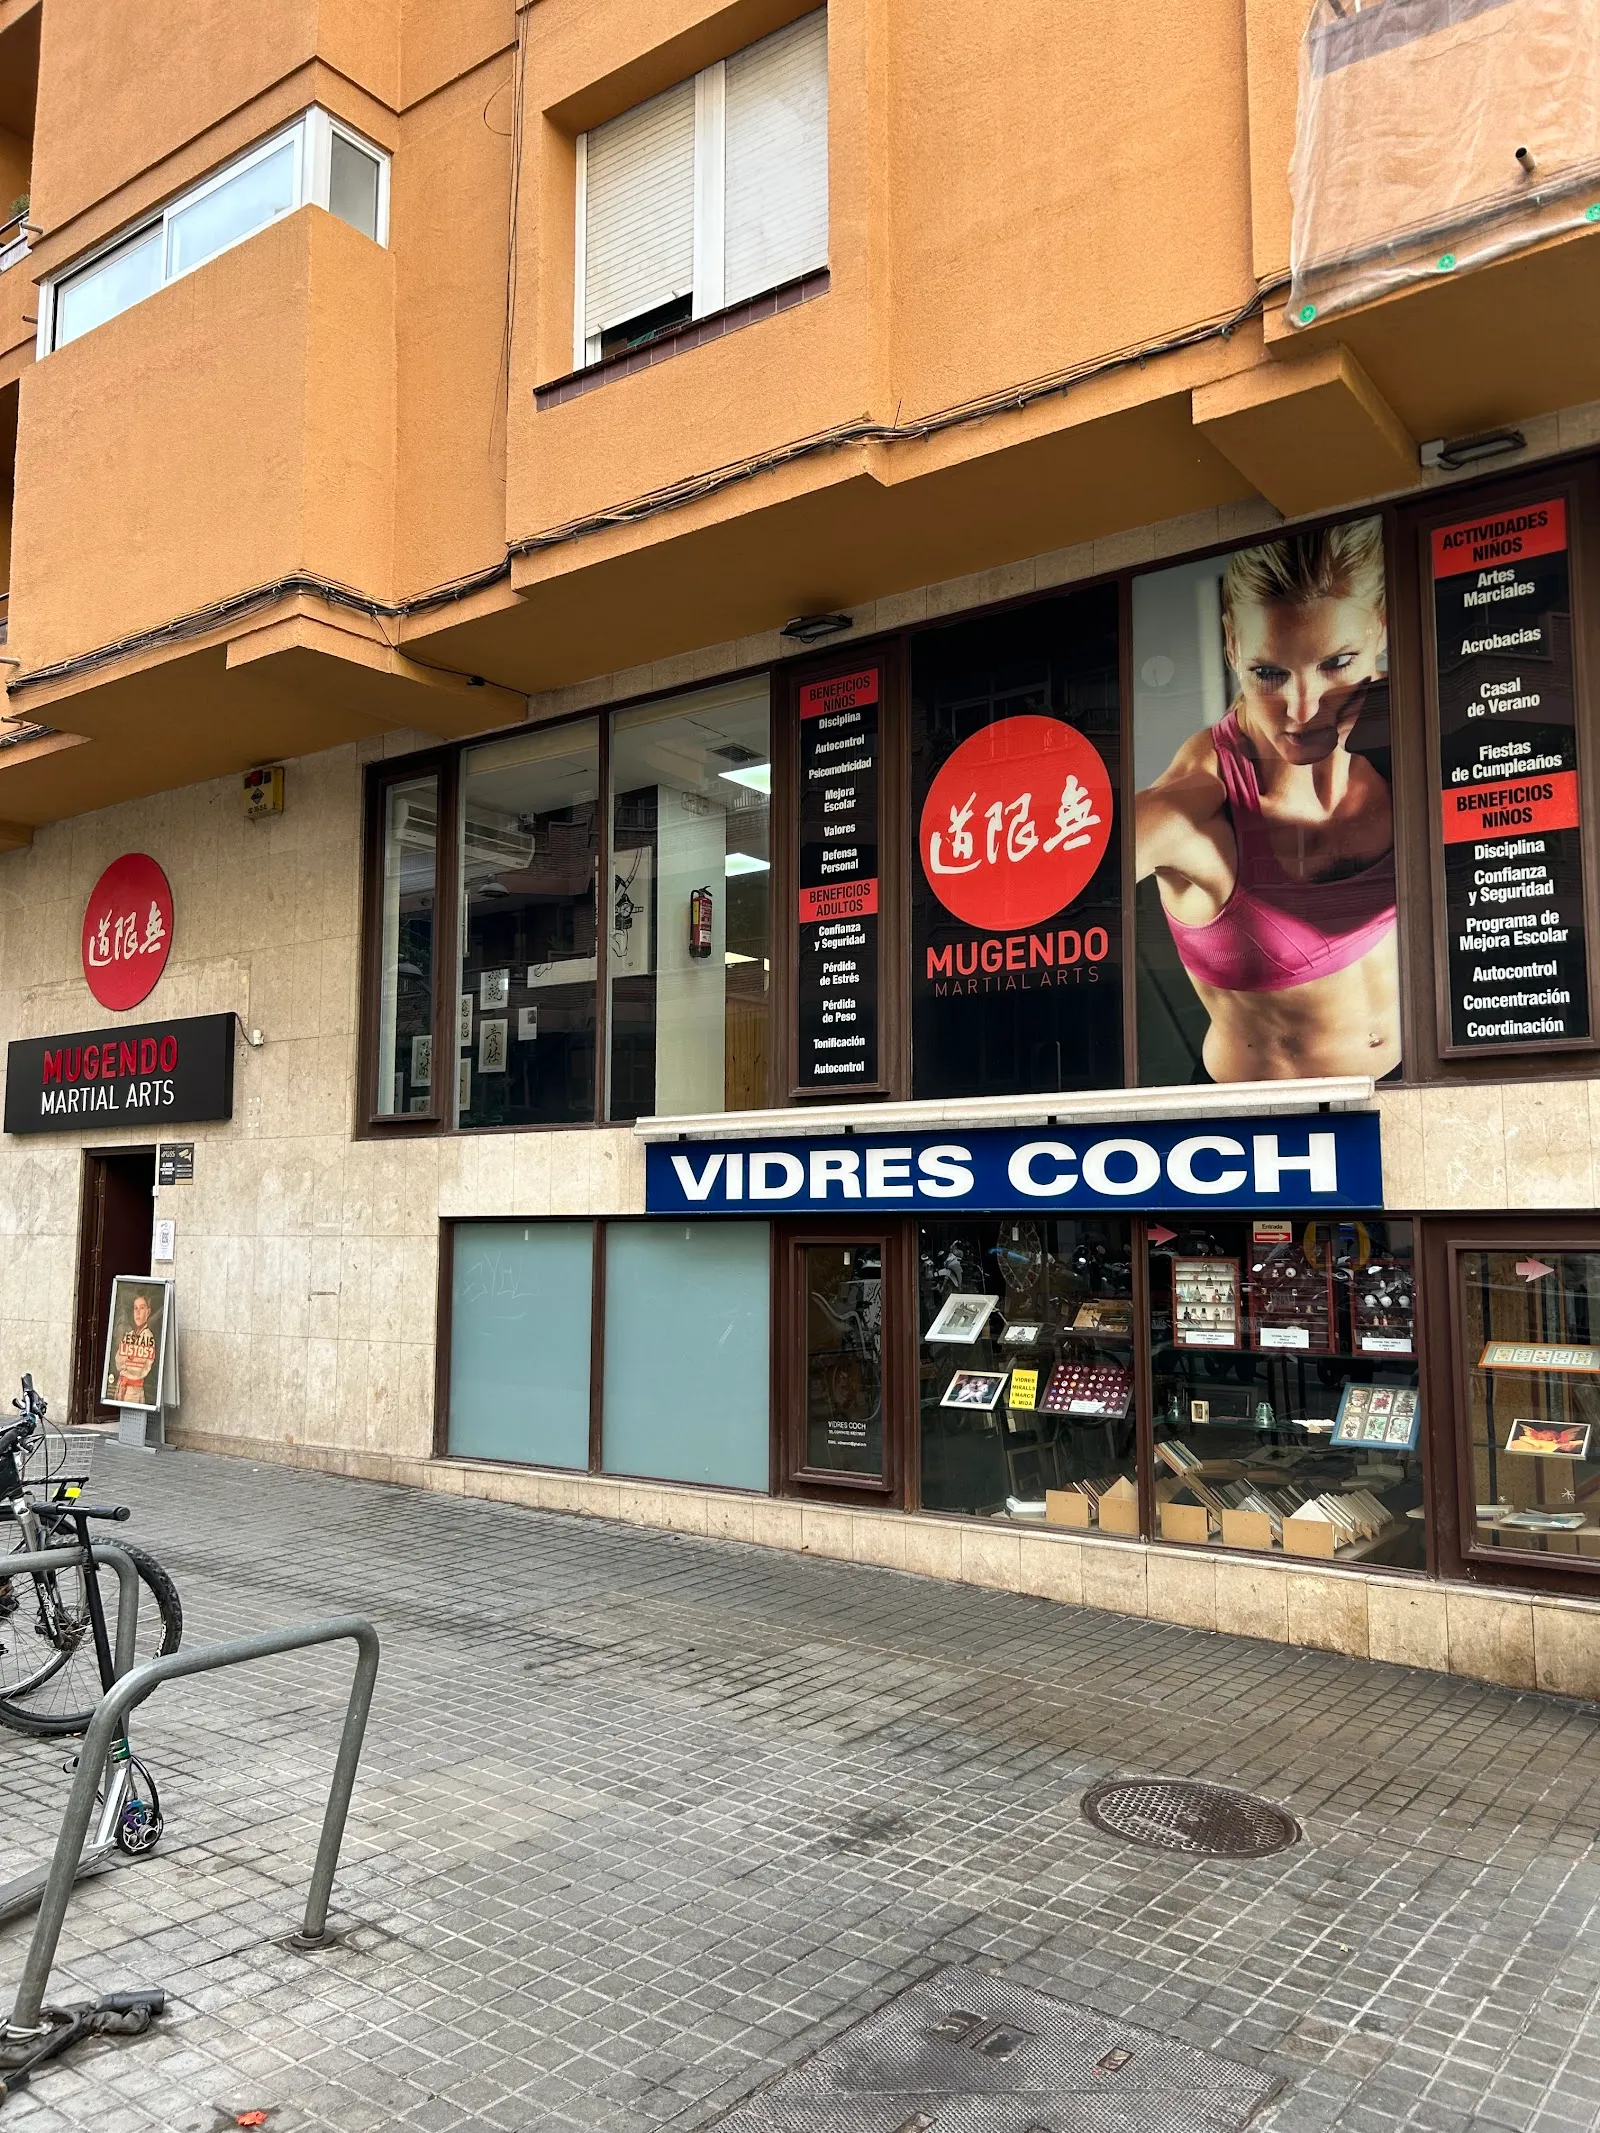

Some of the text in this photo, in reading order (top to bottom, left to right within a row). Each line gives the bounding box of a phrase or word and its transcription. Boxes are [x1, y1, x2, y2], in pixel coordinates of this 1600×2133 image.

[1442, 510, 1549, 551] ACTIVIDADES
[1472, 536, 1523, 564] NIÑOS
[1477, 568, 1516, 589] Artes
[1463, 580, 1536, 608] Marciales
[1461, 627, 1542, 655] Acrobacias
[809, 675, 871, 701] BENEFICIOS
[1480, 677, 1521, 699] Casal
[823, 693, 856, 714] NIÑOS
[1467, 693, 1541, 719] de Verano
[819, 711, 861, 730] Disciplina
[815, 734, 865, 755] Autocontrol
[1479, 741, 1531, 762] Fiestas
[808, 757, 872, 780] Psicomotricidad
[1451, 753, 1563, 783] de Cumpleaños
[825, 787, 855, 802] Mejora
[1456, 783, 1554, 812] BENEFICIOS
[824, 799, 857, 813] Escolar
[1482, 805, 1533, 829] NIÑOS
[824, 823, 856, 838] Valores
[822, 847, 858, 862] Defensa
[1474, 838, 1545, 860] Disciplina
[821, 859, 859, 875] Personal
[1474, 864, 1547, 886] Confianza
[809, 883, 871, 904] BENEFICIOS
[1468, 880, 1554, 906] y Seguridad
[816, 899, 863, 918] ADULTOS
[818, 923, 861, 937] Confianza
[1466, 909, 1560, 936] Programa de
[814, 933, 865, 951] y Seguridad
[1459, 927, 1569, 953] Mejora Escolar
[926, 926, 1109, 979] MUGENDO
[823, 960, 856, 973] Pérdida
[1473, 960, 1557, 982] Autocontrol
[819, 972, 860, 986] de Estrés
[935, 966, 1100, 998] MARTIAL ARTS
[822, 998, 856, 1011] Pérdida
[1463, 988, 1571, 1011] Concentración
[822, 1011, 856, 1023] de Peso
[1467, 1016, 1564, 1038] Coordinación
[813, 1035, 866, 1050] Tonificación
[42, 1035, 179, 1085] MUGENDO
[814, 1061, 865, 1075] Autocontrol
[41, 1079, 175, 1116] MARTIAL ARTS
[671, 1133, 1338, 1201] VIDRES COCH
[120, 1344, 154, 1359] LISTOS?
[828, 1420, 866, 1430] VIDRES COCH
